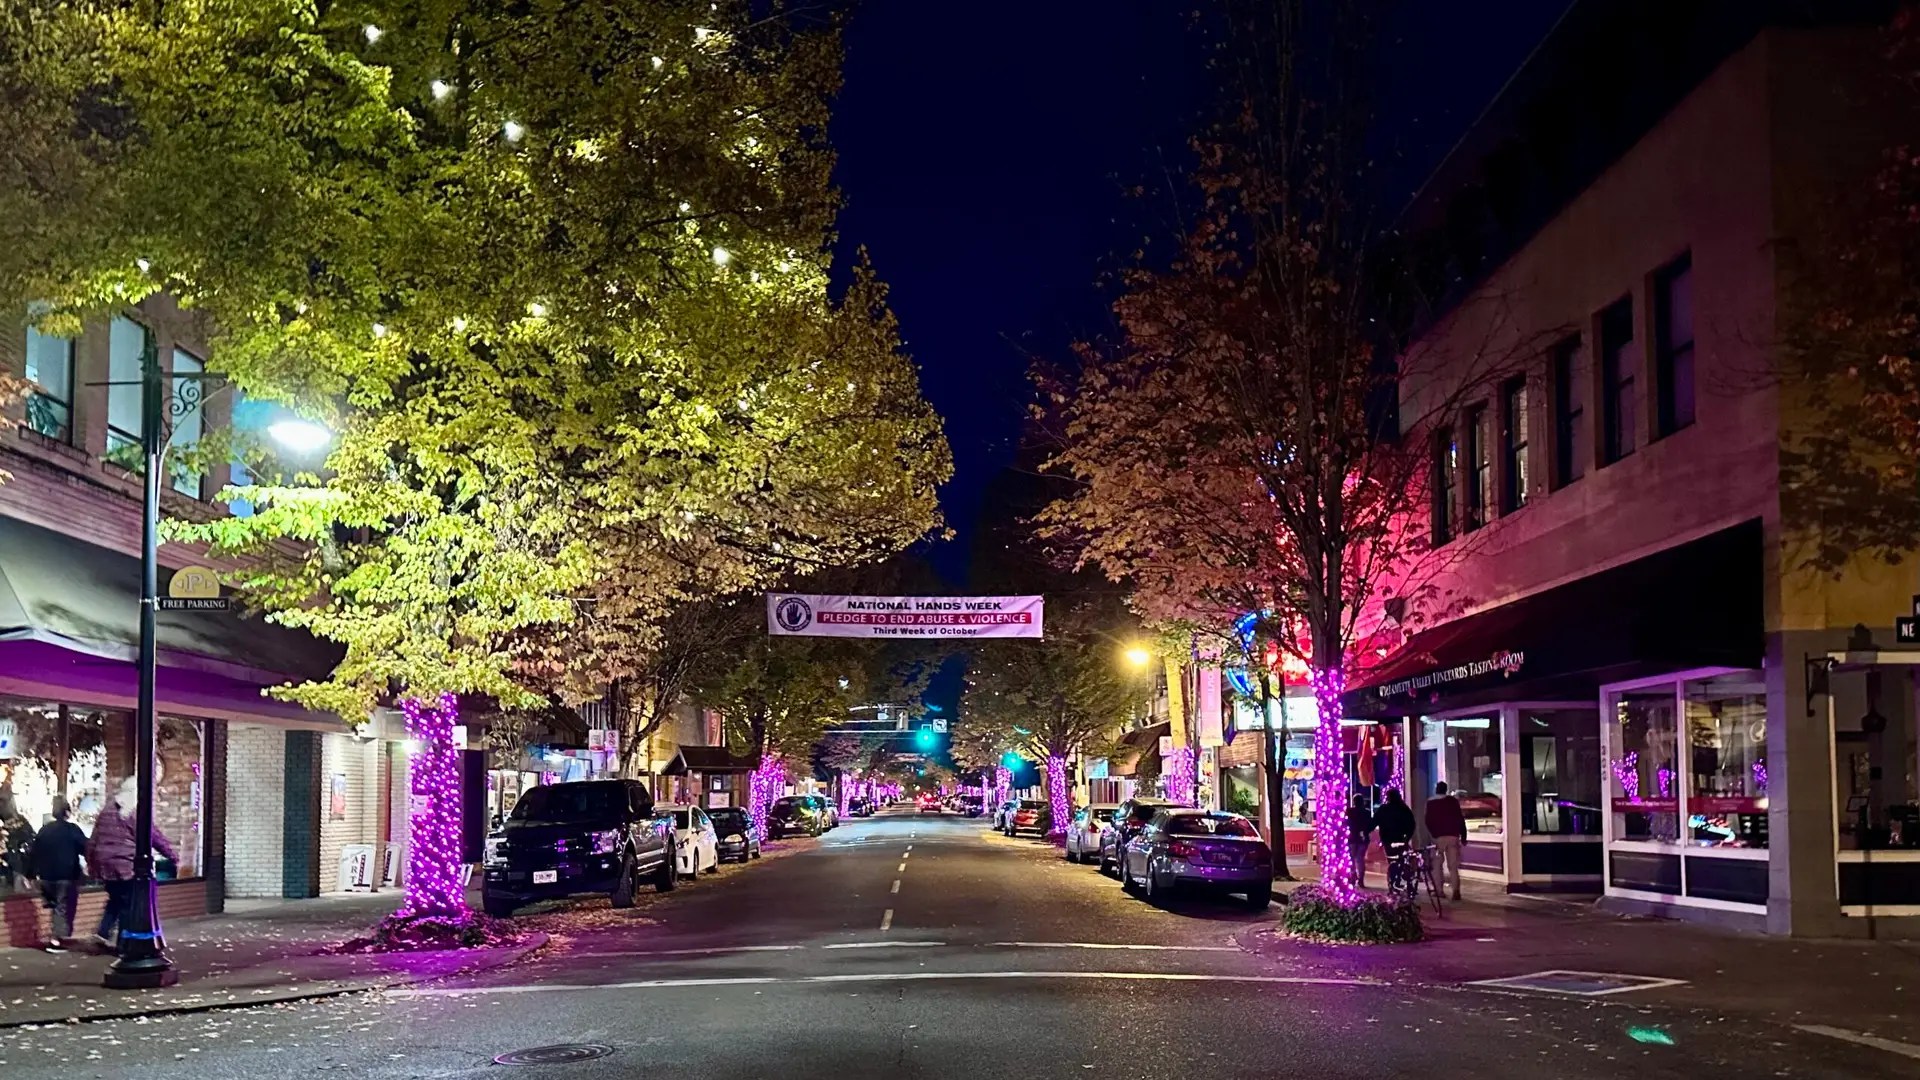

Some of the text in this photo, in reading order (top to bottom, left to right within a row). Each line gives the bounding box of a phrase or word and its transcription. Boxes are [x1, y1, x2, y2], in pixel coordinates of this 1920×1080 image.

[185, 573, 203, 593] P
[162, 600, 226, 609] FREE PARKING
[847, 601, 1002, 610] NATIONAL HANDS WEEK
[823, 613, 1027, 624] PLEDGE TO END ABUSE & VIOLENCE
[872, 627, 977, 635] Third Week of October
[1901, 623, 1915, 637] NE
[1432, 665, 1468, 684] VINEYARDS
